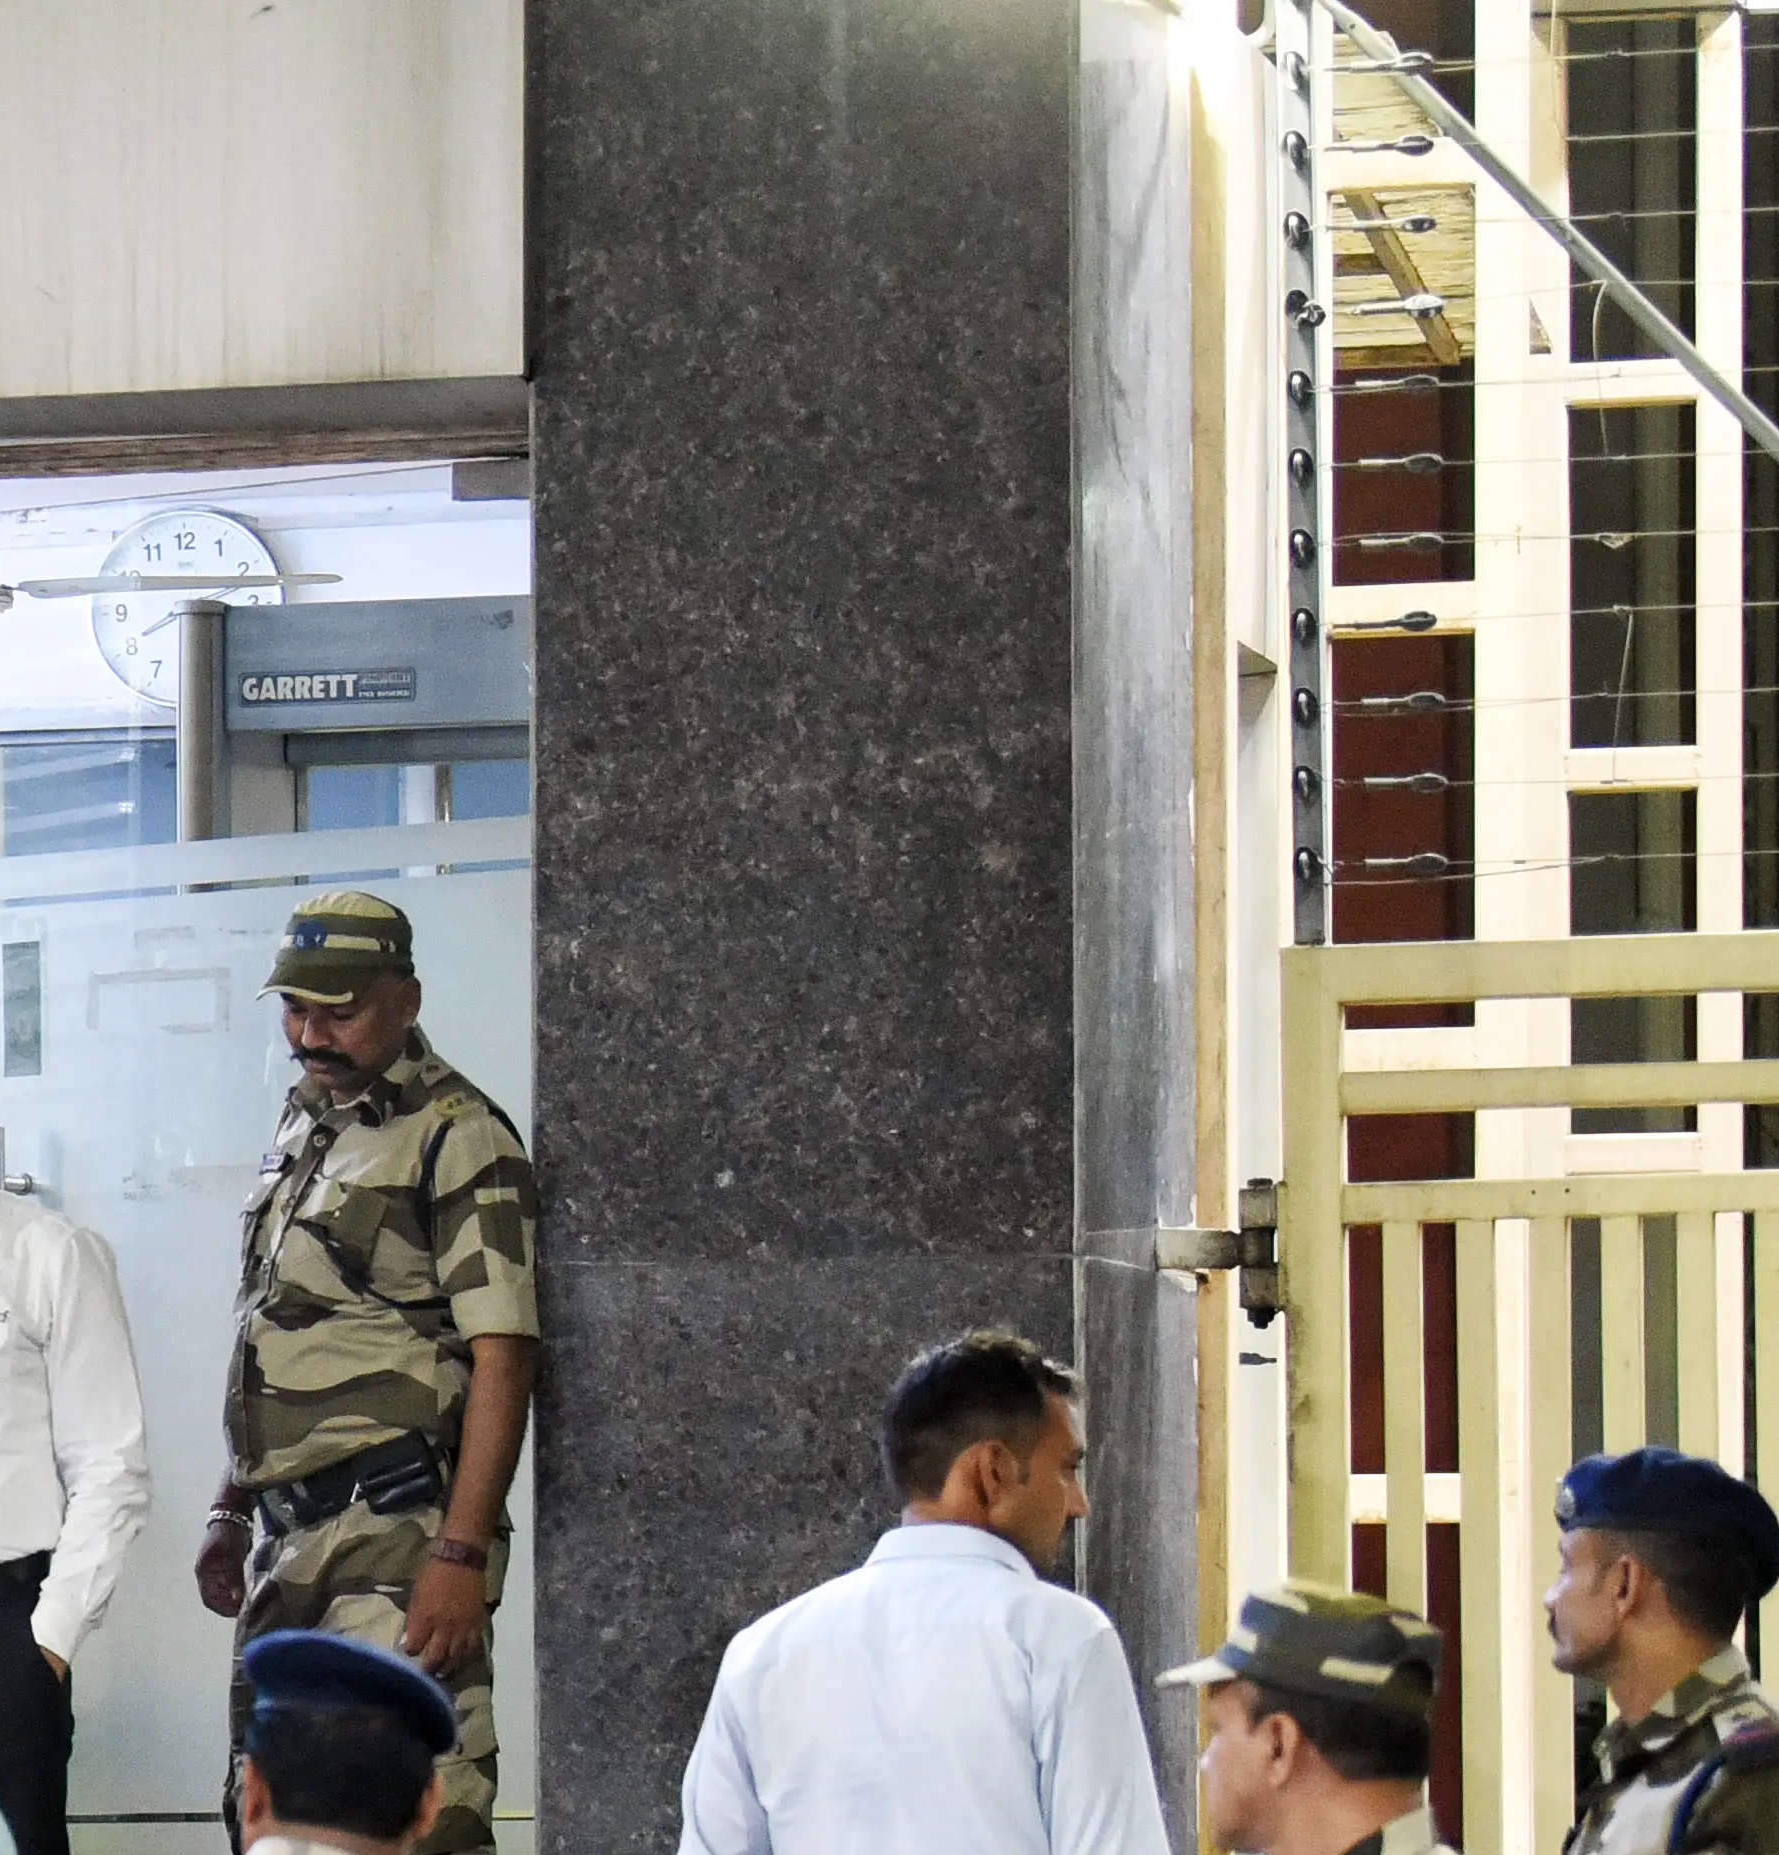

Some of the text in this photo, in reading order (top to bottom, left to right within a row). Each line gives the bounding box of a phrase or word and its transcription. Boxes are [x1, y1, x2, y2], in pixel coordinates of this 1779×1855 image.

[173, 531, 196, 551] 12
[213, 538, 223, 557] 1
[143, 542, 162, 562] 11
[237, 561, 250, 577] 2
[115, 603, 128, 623] 9
[125, 636, 138, 656] 8
[150, 659, 163, 679] 7
[242, 673, 359, 701] GARRETT
